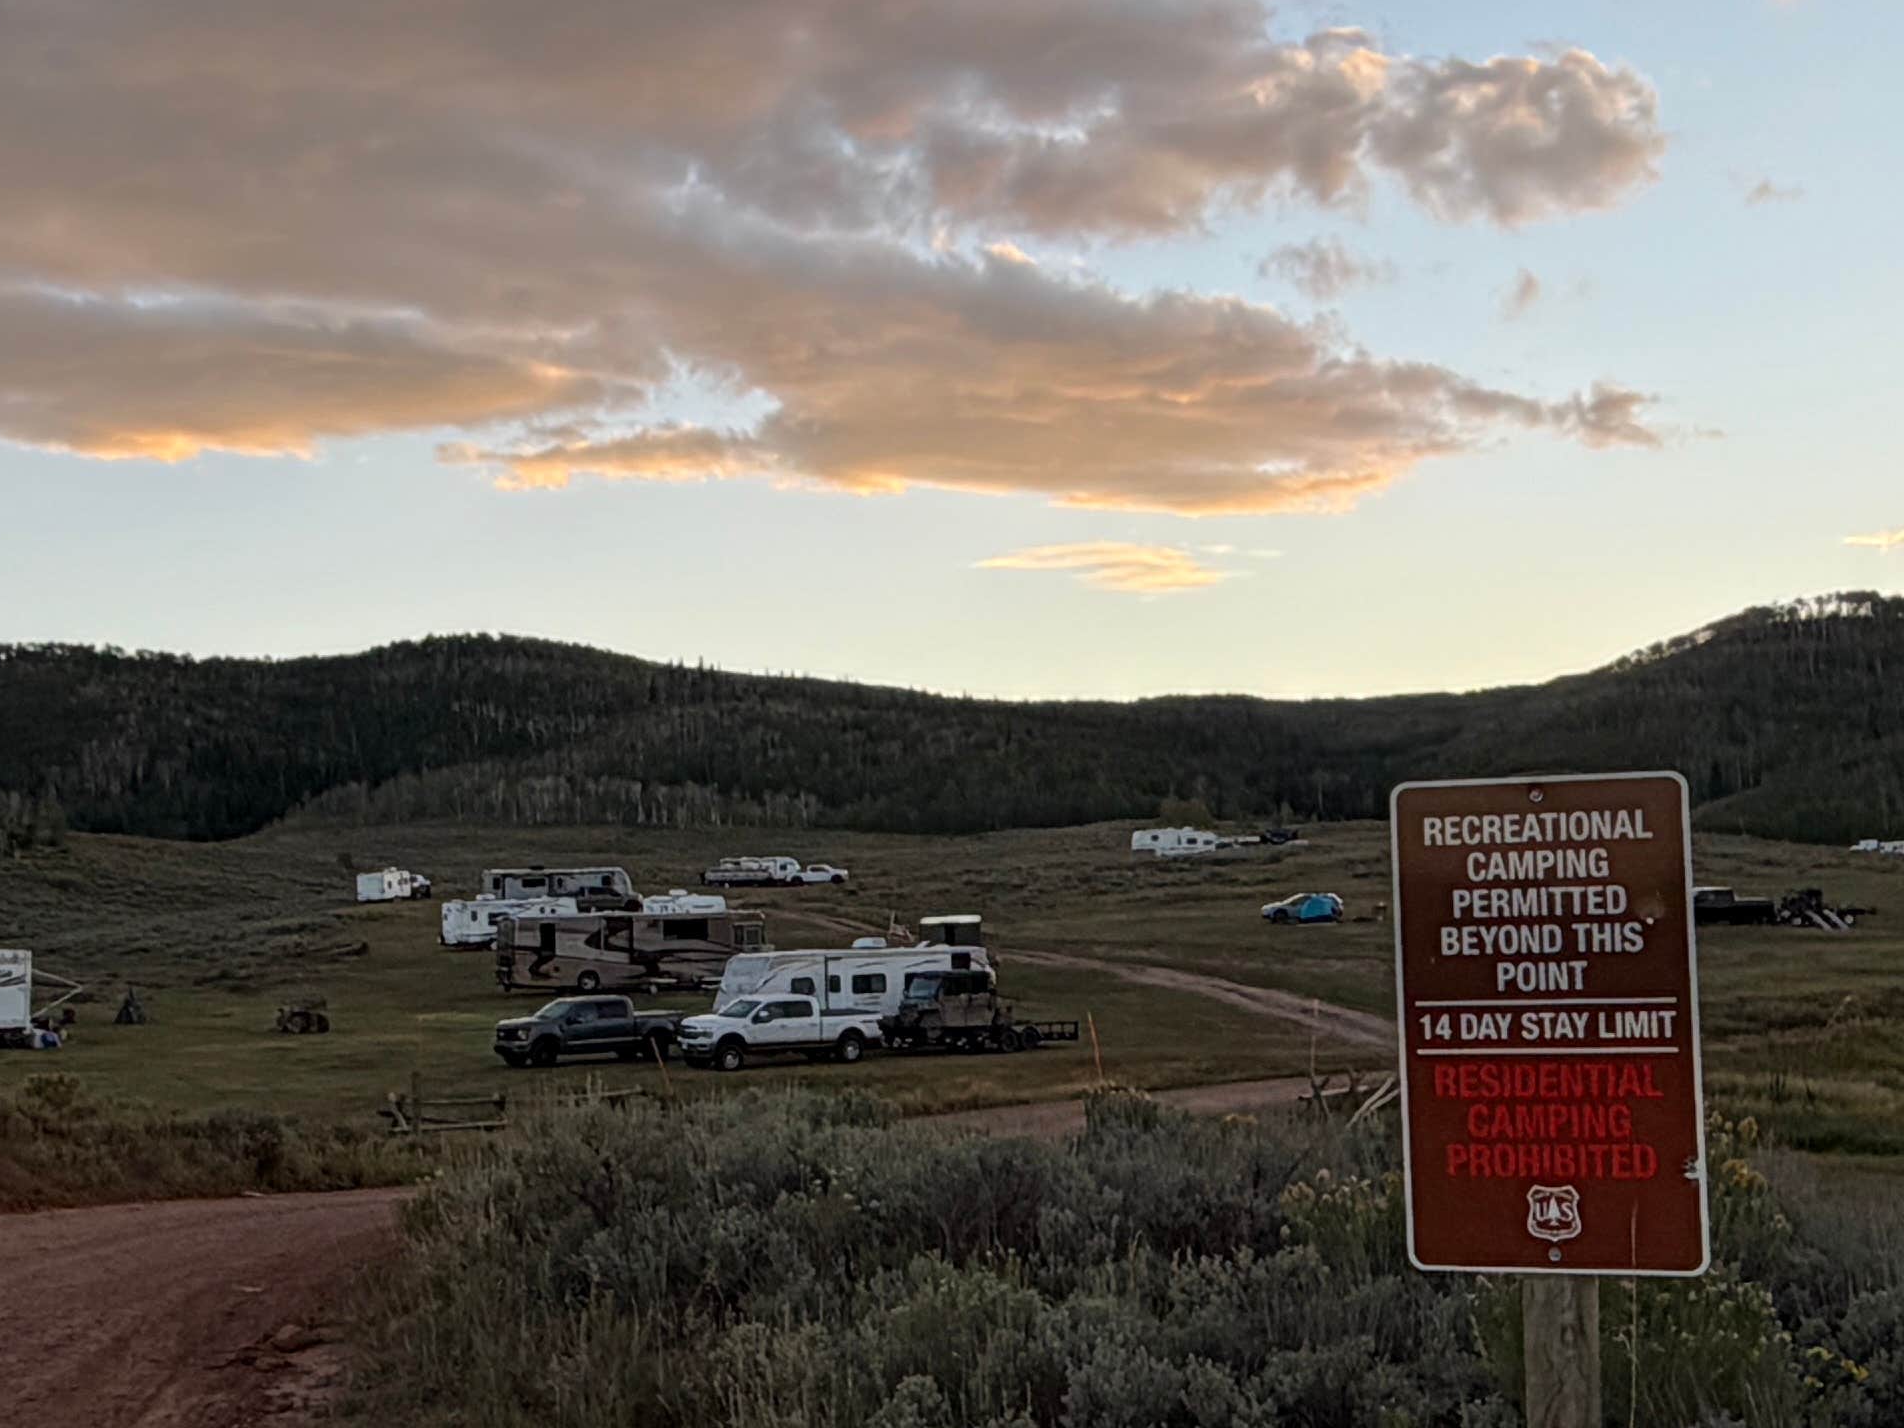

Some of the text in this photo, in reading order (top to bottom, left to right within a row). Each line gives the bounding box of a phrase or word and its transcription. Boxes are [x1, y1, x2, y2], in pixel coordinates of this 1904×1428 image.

[1424, 809, 1653, 845] RECREATIONAL
[1467, 849, 1609, 881] CAMPING
[1454, 885, 1627, 918] PERMITTED
[1441, 922, 1644, 955] BEYOND THIS
[1498, 961, 1587, 992] POINT
[1419, 1011, 1677, 1040] 14 DAY STAY LIMIT
[1434, 1063, 1663, 1098] RESIDENTIAL
[1467, 1105, 1631, 1138] CAMPING
[1446, 1143, 1656, 1179] PROHIBITED
